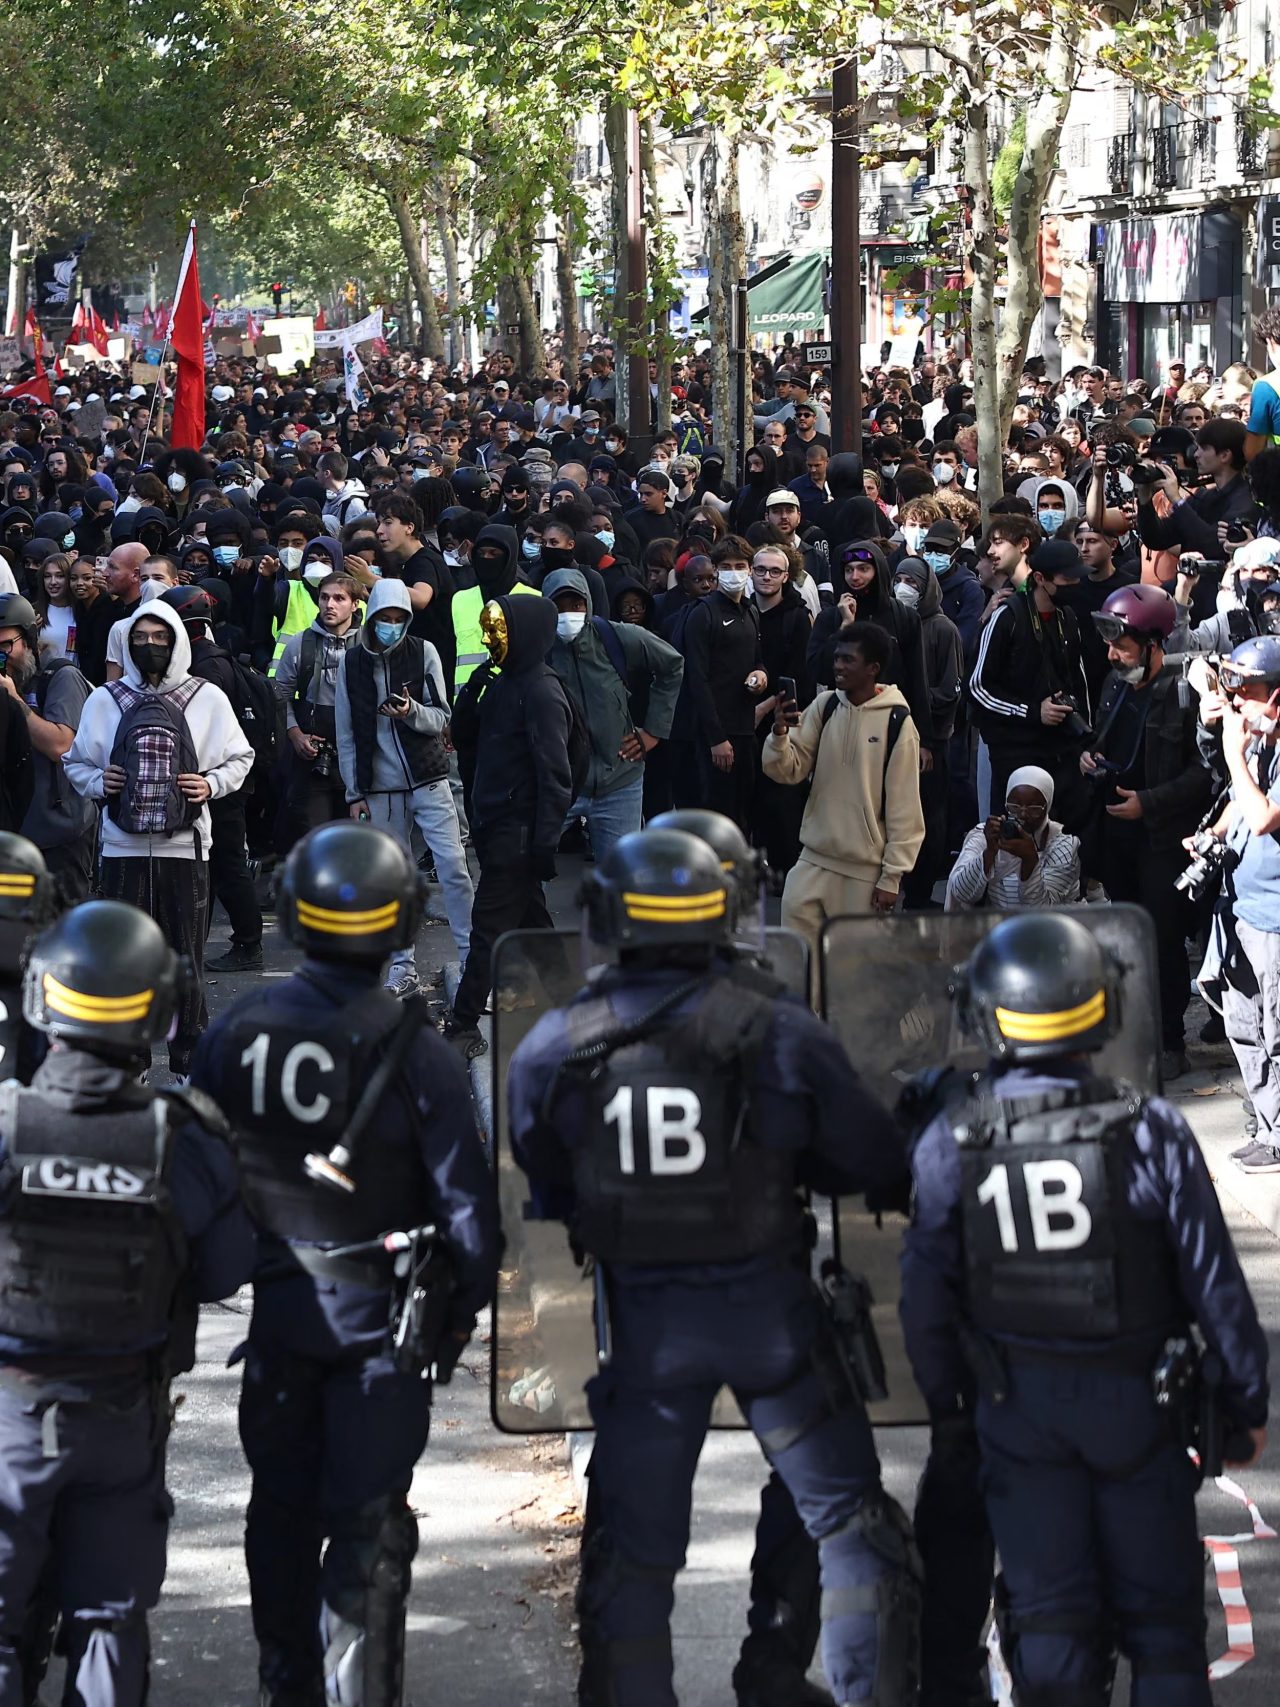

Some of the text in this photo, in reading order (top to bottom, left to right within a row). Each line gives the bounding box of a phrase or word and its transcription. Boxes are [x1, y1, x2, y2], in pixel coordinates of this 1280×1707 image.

[754, 311, 816, 324] LEOPARD
[809, 349, 827, 360] 159
[240, 1032, 335, 1124] 1C
[602, 1085, 707, 1176] 1B
[976, 1159, 1093, 1254] 1B
